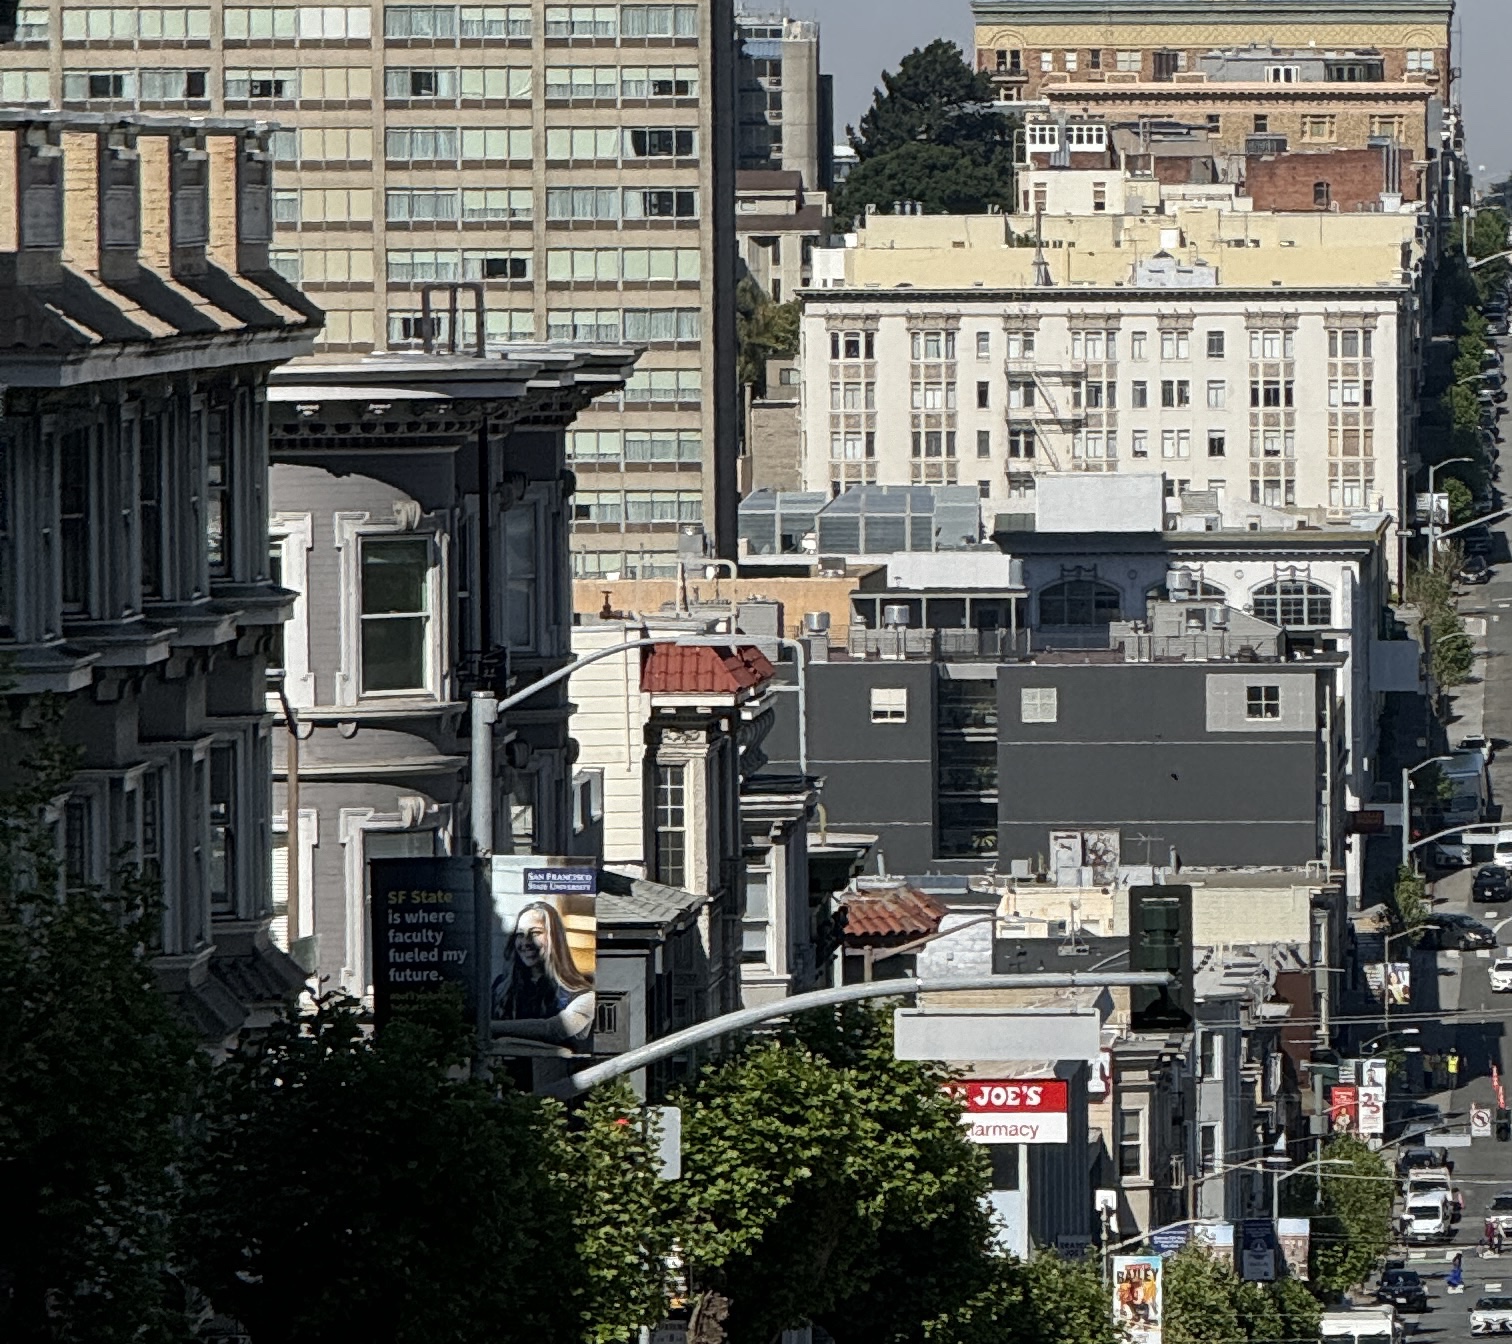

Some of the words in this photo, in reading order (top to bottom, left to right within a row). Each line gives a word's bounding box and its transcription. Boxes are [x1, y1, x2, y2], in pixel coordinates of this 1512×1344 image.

[387, 890, 407, 905] SF
[411, 890, 453, 904] State
[387, 909, 401, 924] is
[404, 909, 455, 924] where
[388, 928, 444, 946] faculty
[388, 947, 438, 963] fueled
[442, 950, 468, 964] my
[388, 968, 444, 982] future.
[973, 1086, 1043, 1107] JOE'S
[970, 1122, 1039, 1140] armacy
